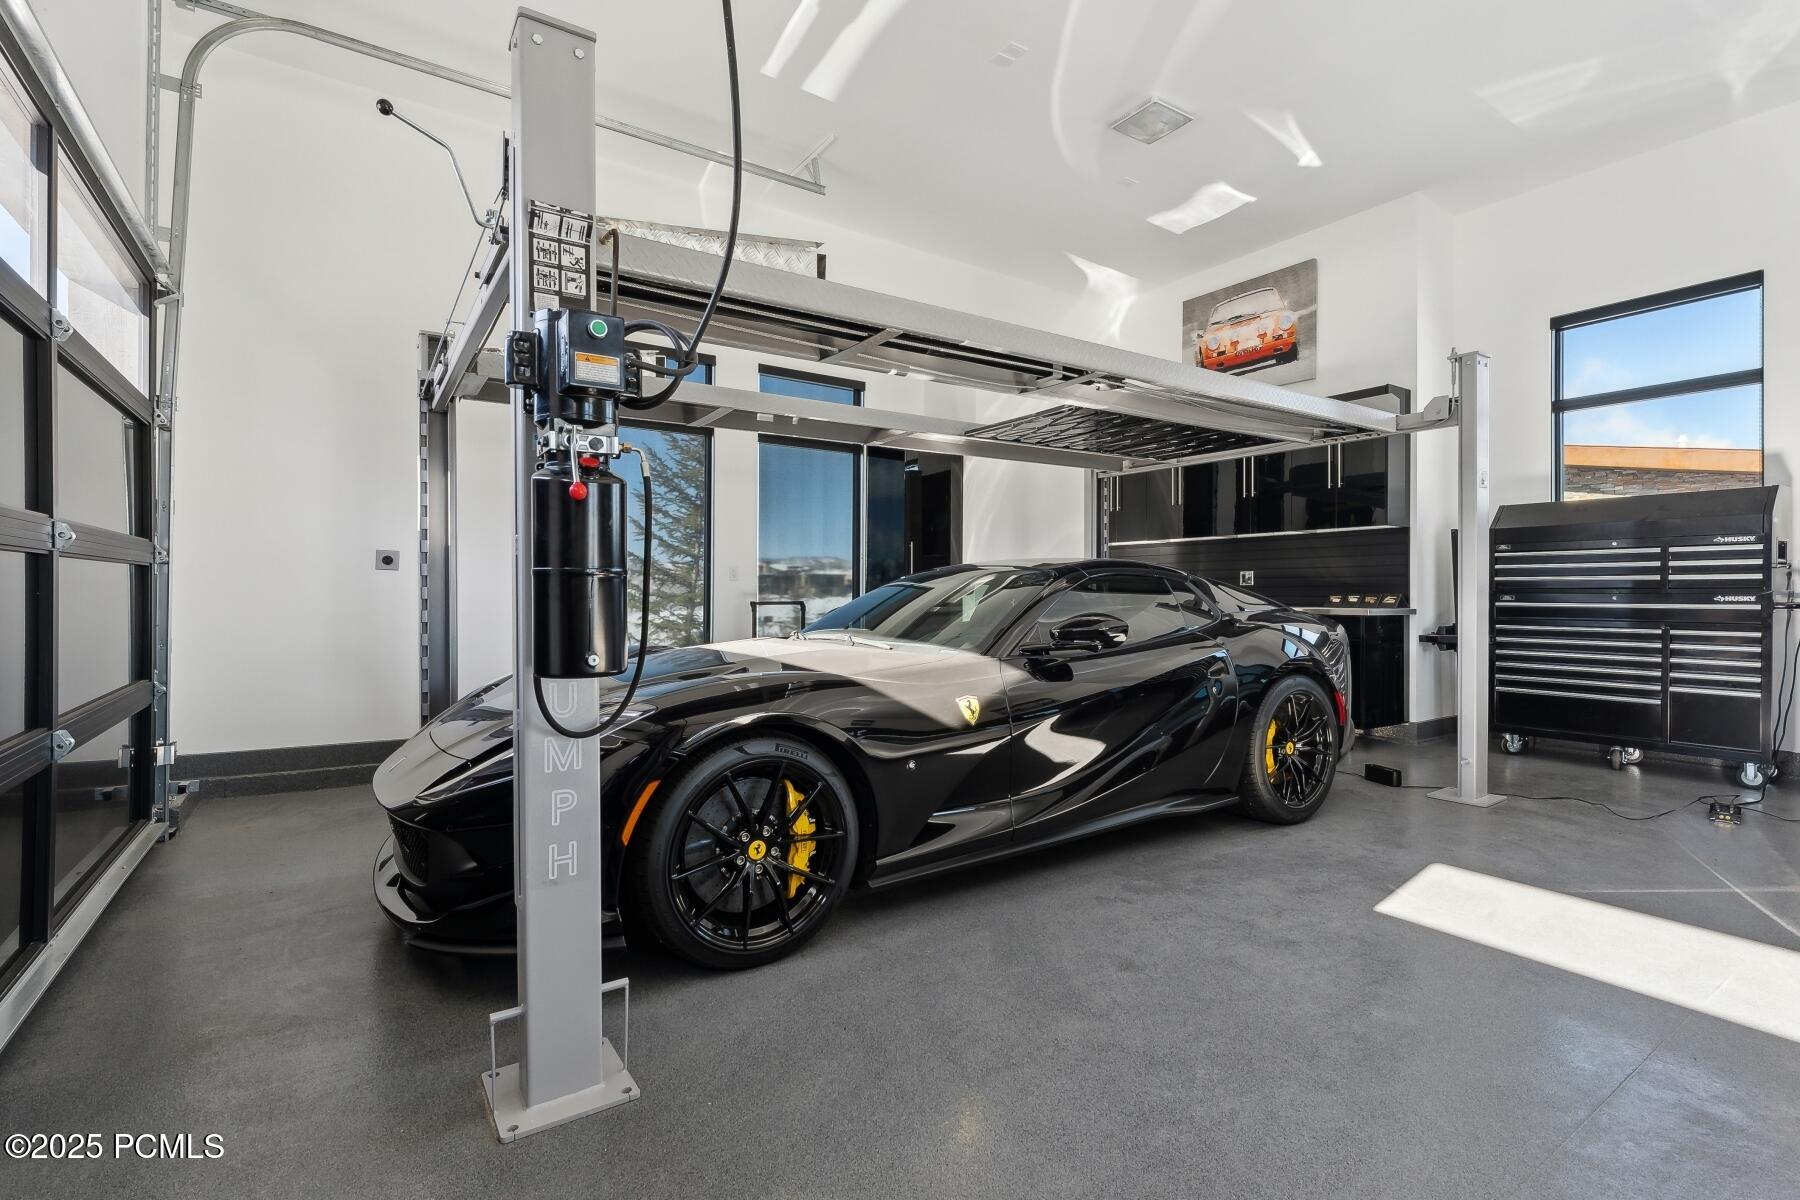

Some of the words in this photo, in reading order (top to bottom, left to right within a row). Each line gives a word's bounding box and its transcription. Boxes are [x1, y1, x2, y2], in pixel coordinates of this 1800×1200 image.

[1724, 535, 1756, 543] HUSKY
[775, 743, 809, 761] PIRELLI
[544, 681, 582, 880] UMPH
